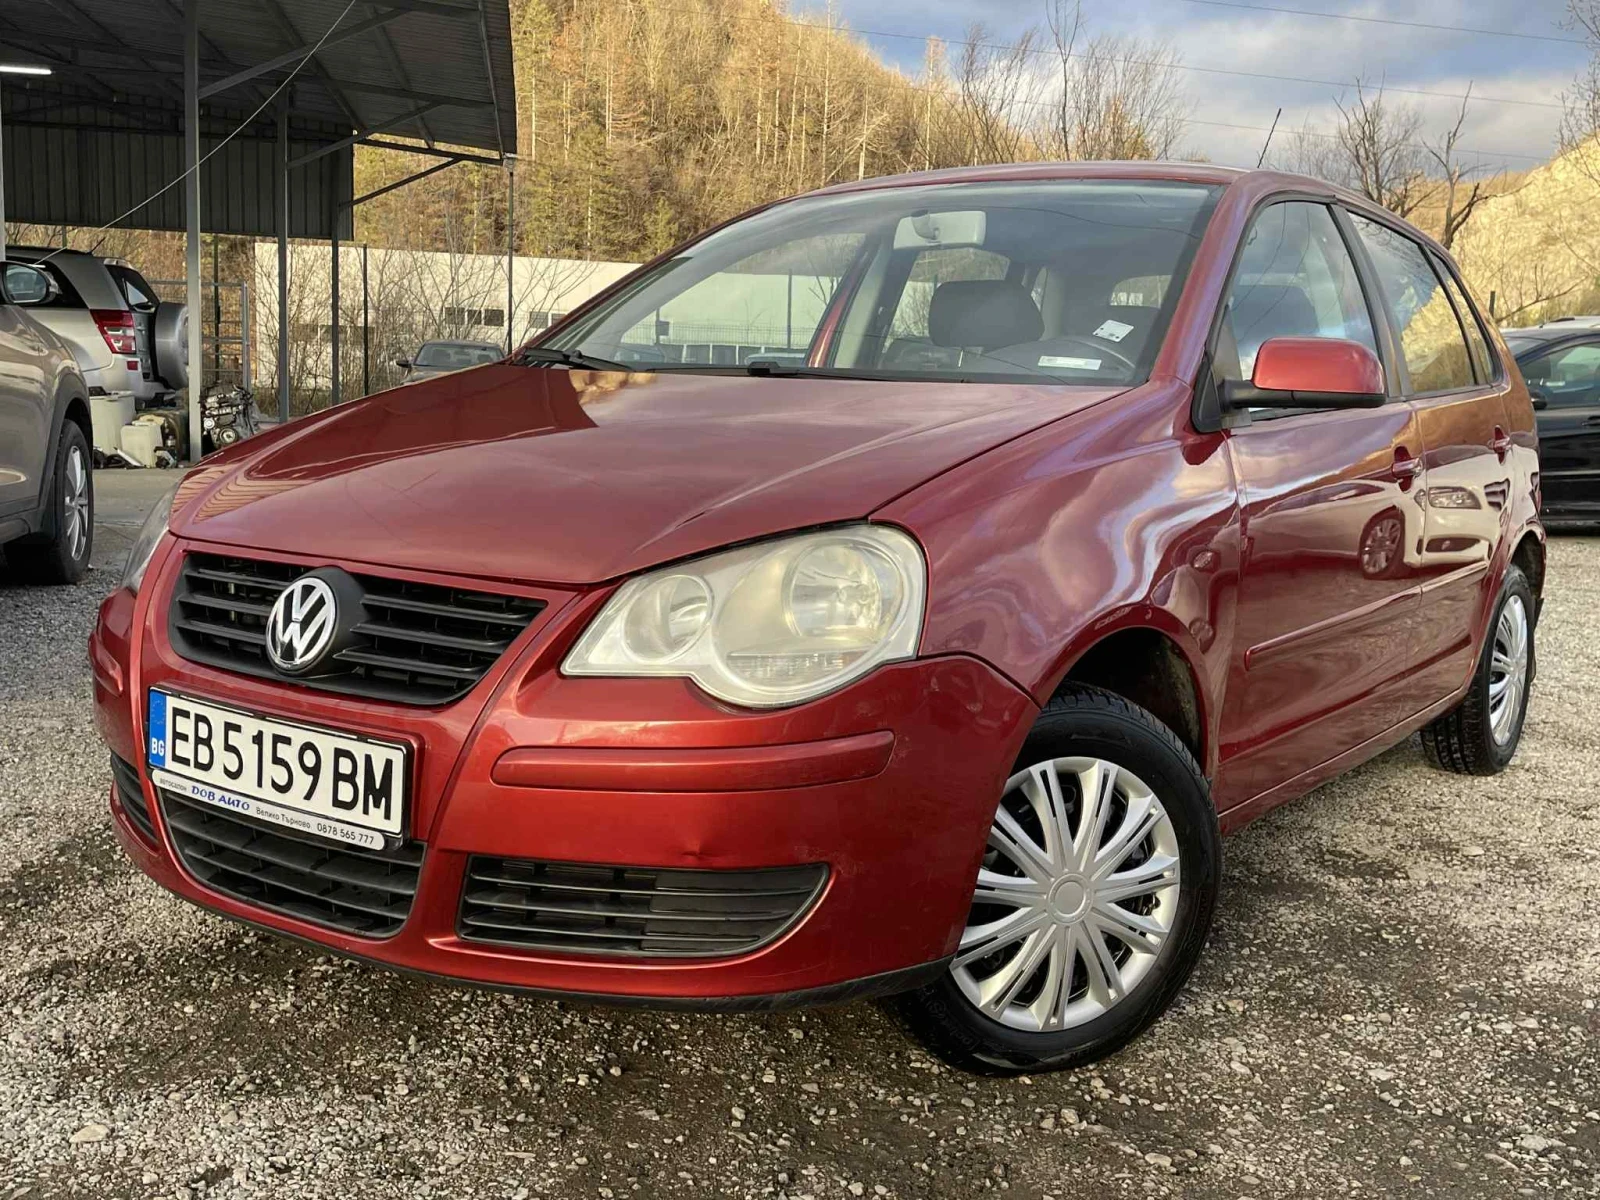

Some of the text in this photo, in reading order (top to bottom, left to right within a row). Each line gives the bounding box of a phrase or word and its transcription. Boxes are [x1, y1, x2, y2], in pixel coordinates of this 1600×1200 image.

[151, 737, 165, 756] BG
[191, 785, 215, 801] DOB
[256, 806, 280, 821] Велико
[317, 822, 374, 845] 0878 565 777
